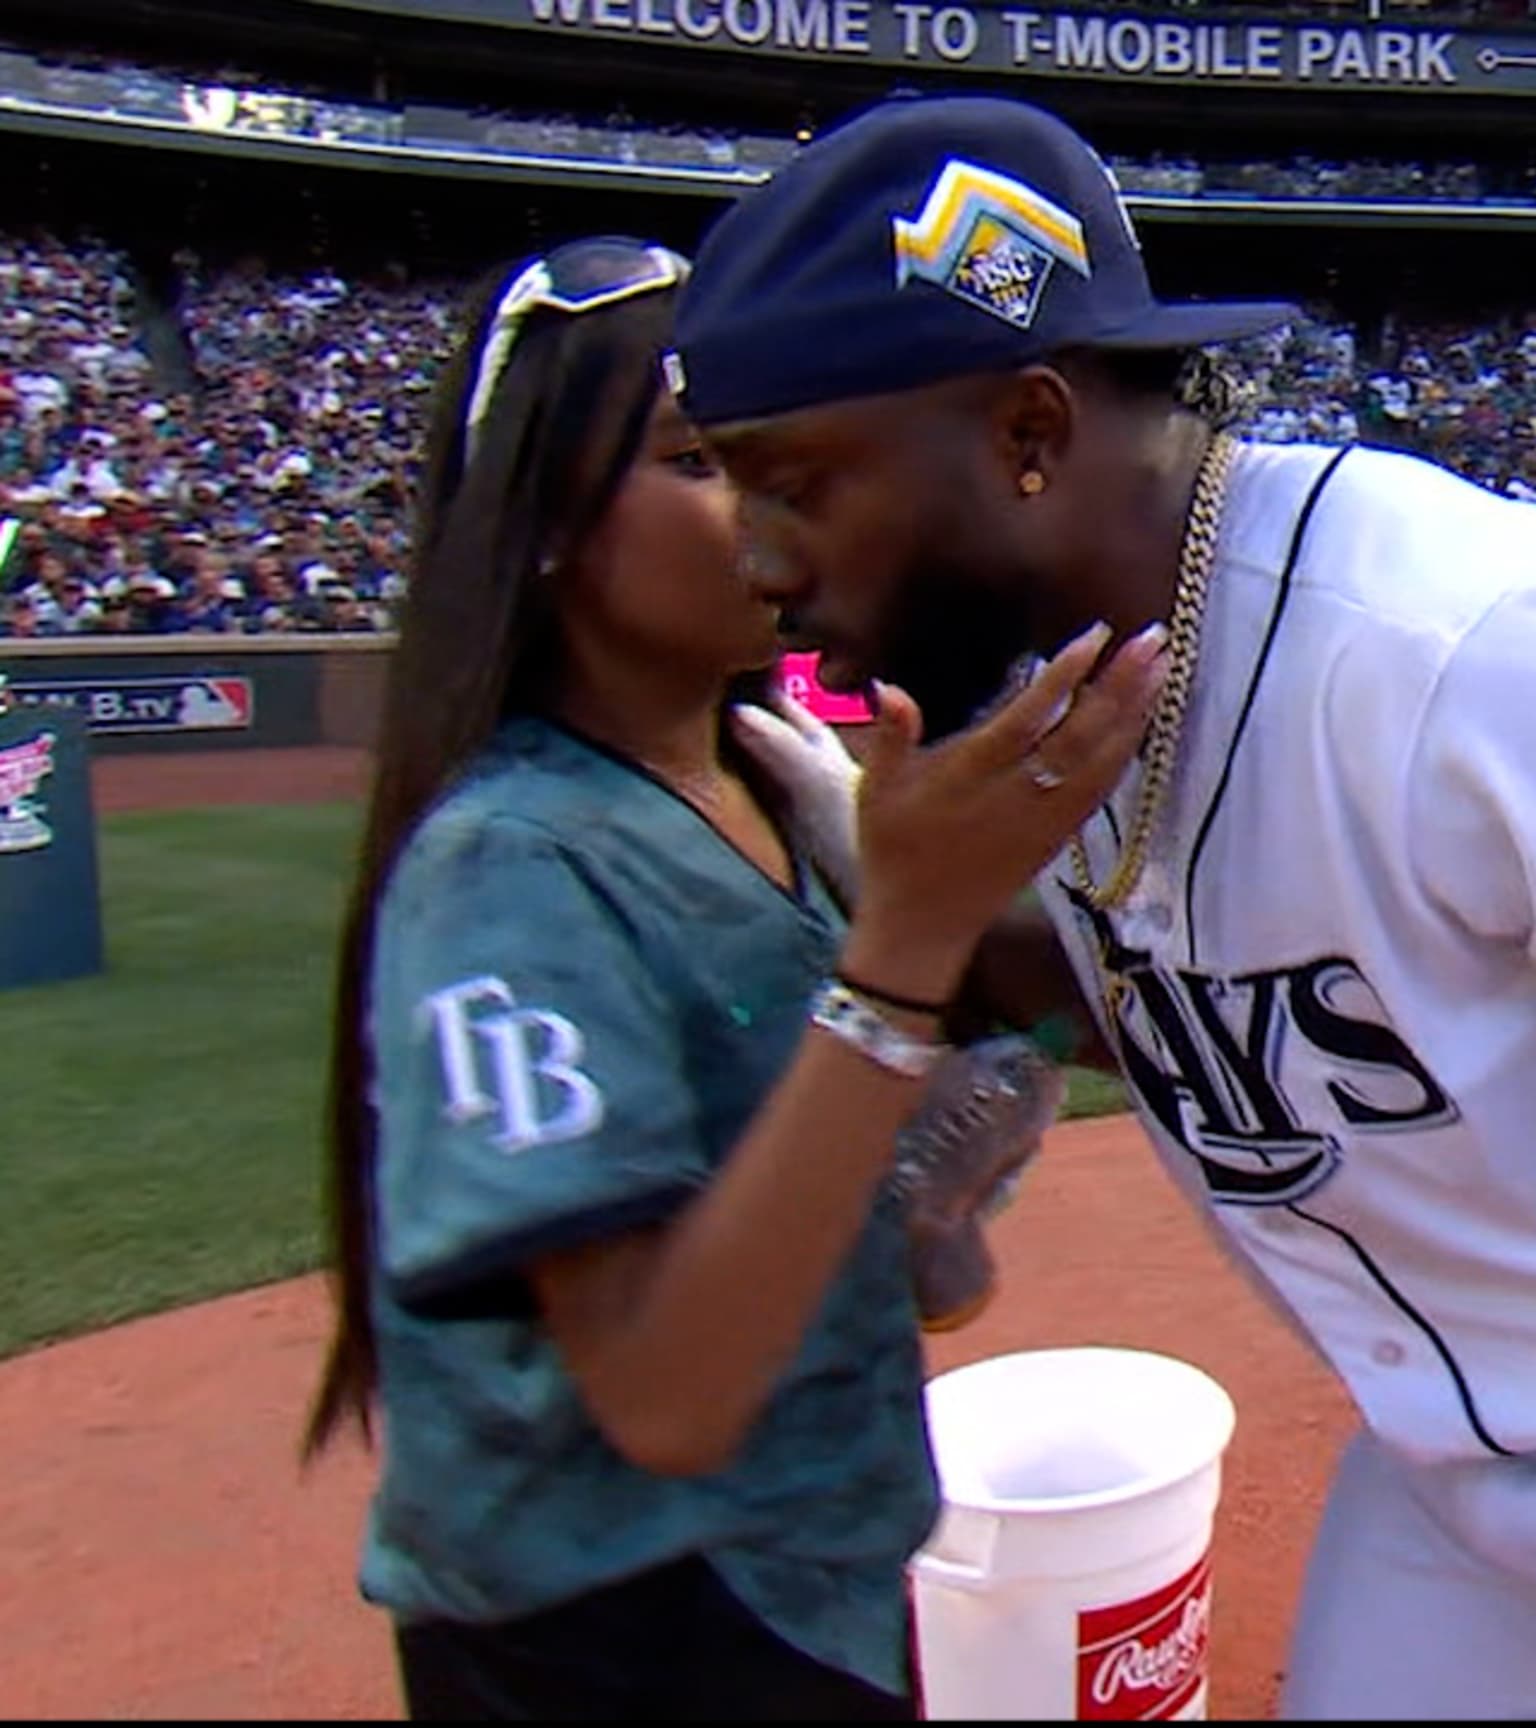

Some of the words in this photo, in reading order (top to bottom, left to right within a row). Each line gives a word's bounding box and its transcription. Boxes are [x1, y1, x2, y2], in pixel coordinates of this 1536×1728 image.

[895, 4, 978, 60] TO
[1002, 12, 1282, 76] T-MOBILE
[1299, 29, 1457, 83] PARK
[413, 974, 604, 1154] TB
